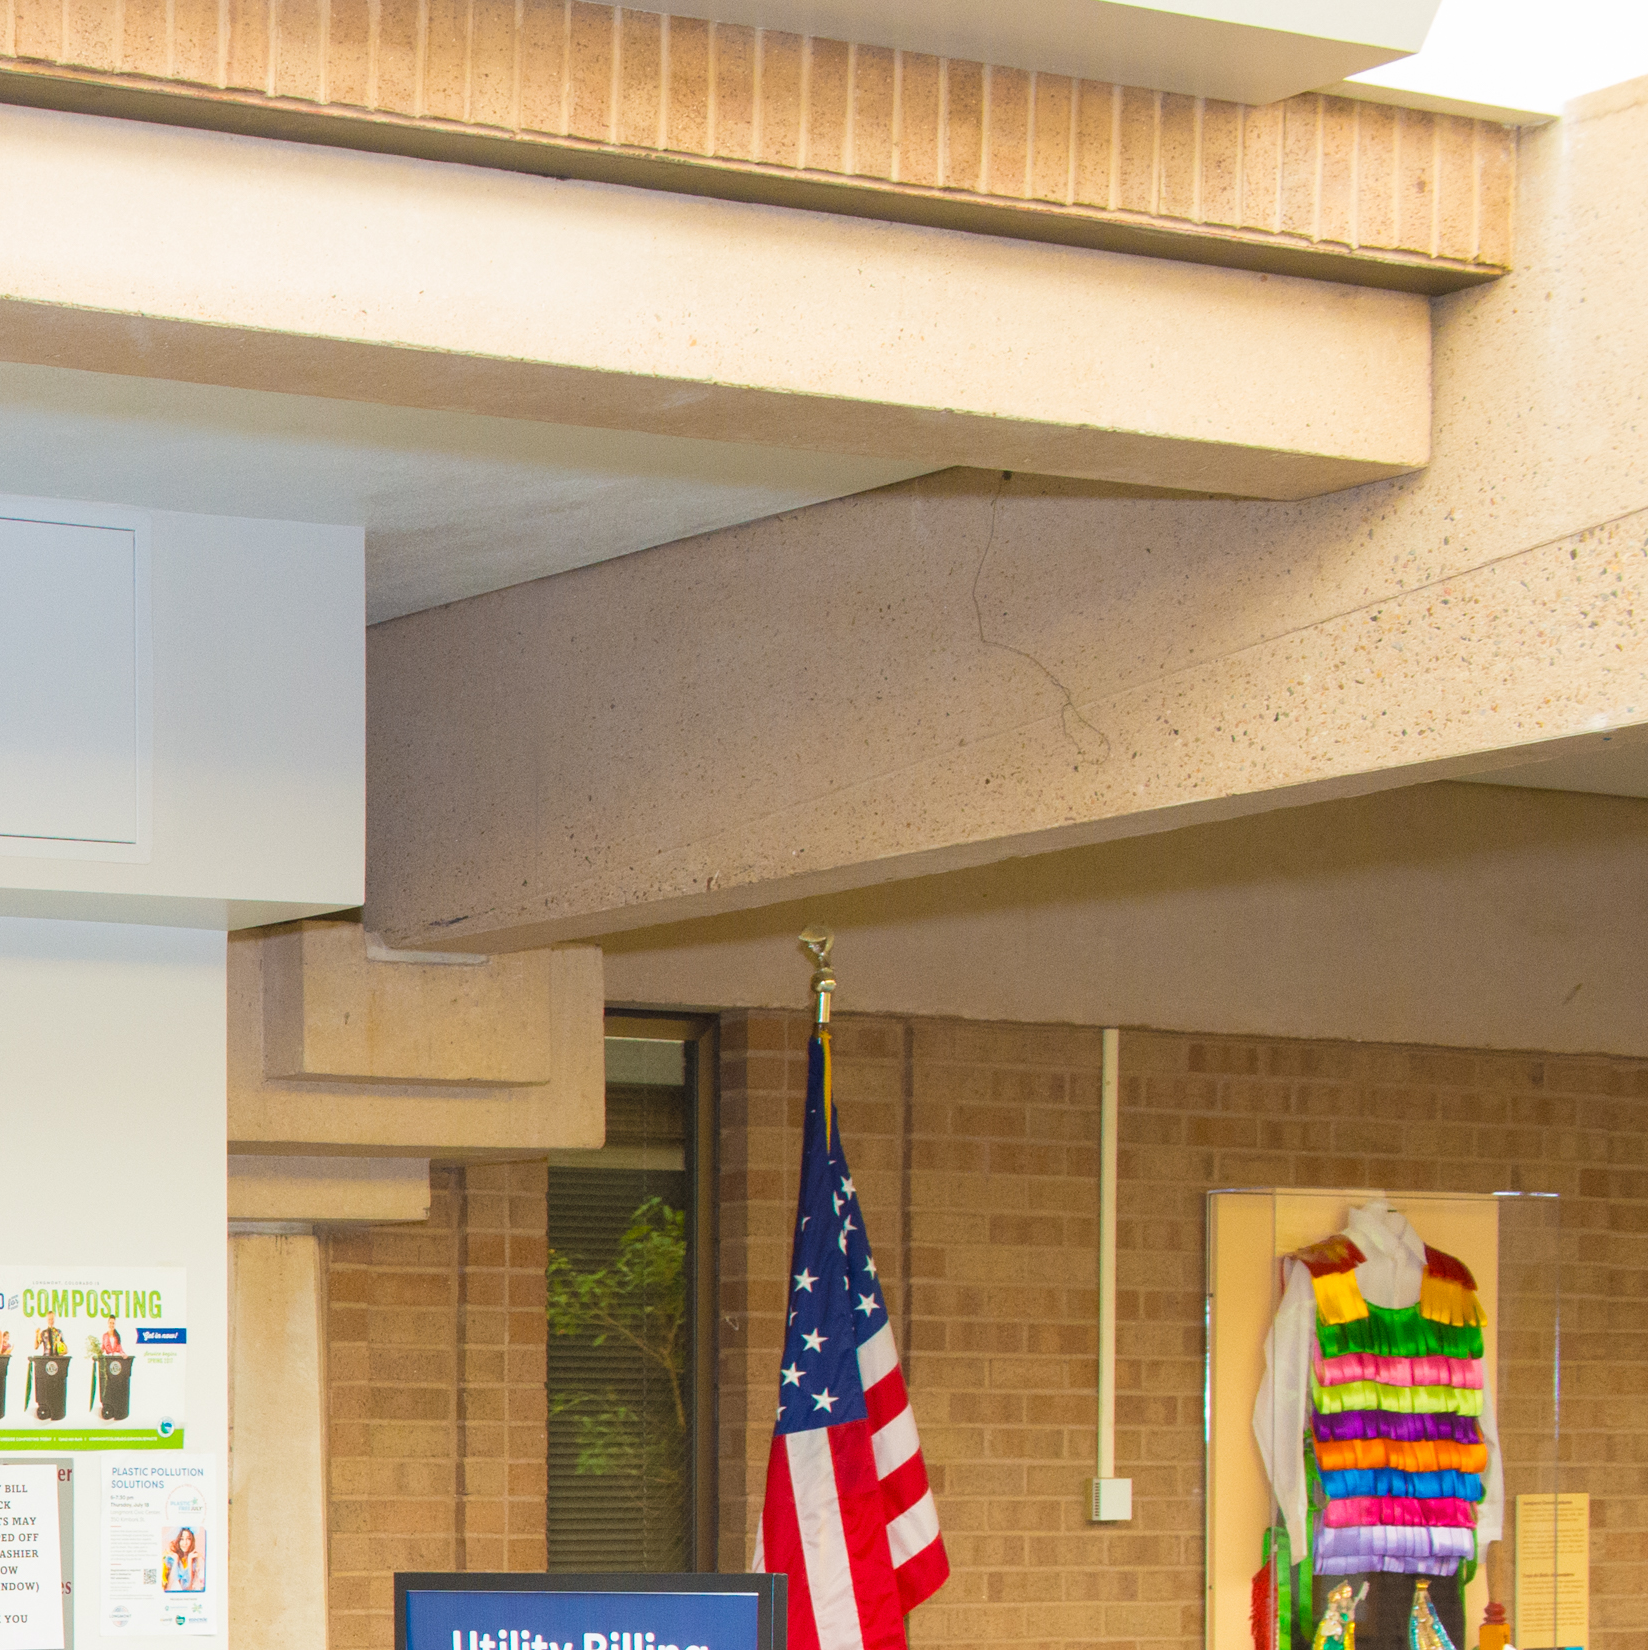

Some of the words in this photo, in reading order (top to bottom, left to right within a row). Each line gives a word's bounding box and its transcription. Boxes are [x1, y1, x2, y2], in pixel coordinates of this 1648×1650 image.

[23, 1289, 162, 1318] COMPOSTING
[112, 1467, 148, 1476] PLASTIC
[151, 1468, 203, 1476] POLLUTION
[5, 1485, 28, 1493] BILL
[111, 1480, 164, 1489] SOLUTIONS
[13, 1517, 37, 1525] MAY
[19, 1533, 39, 1542] OFF
[5, 1615, 28, 1623] YOU
